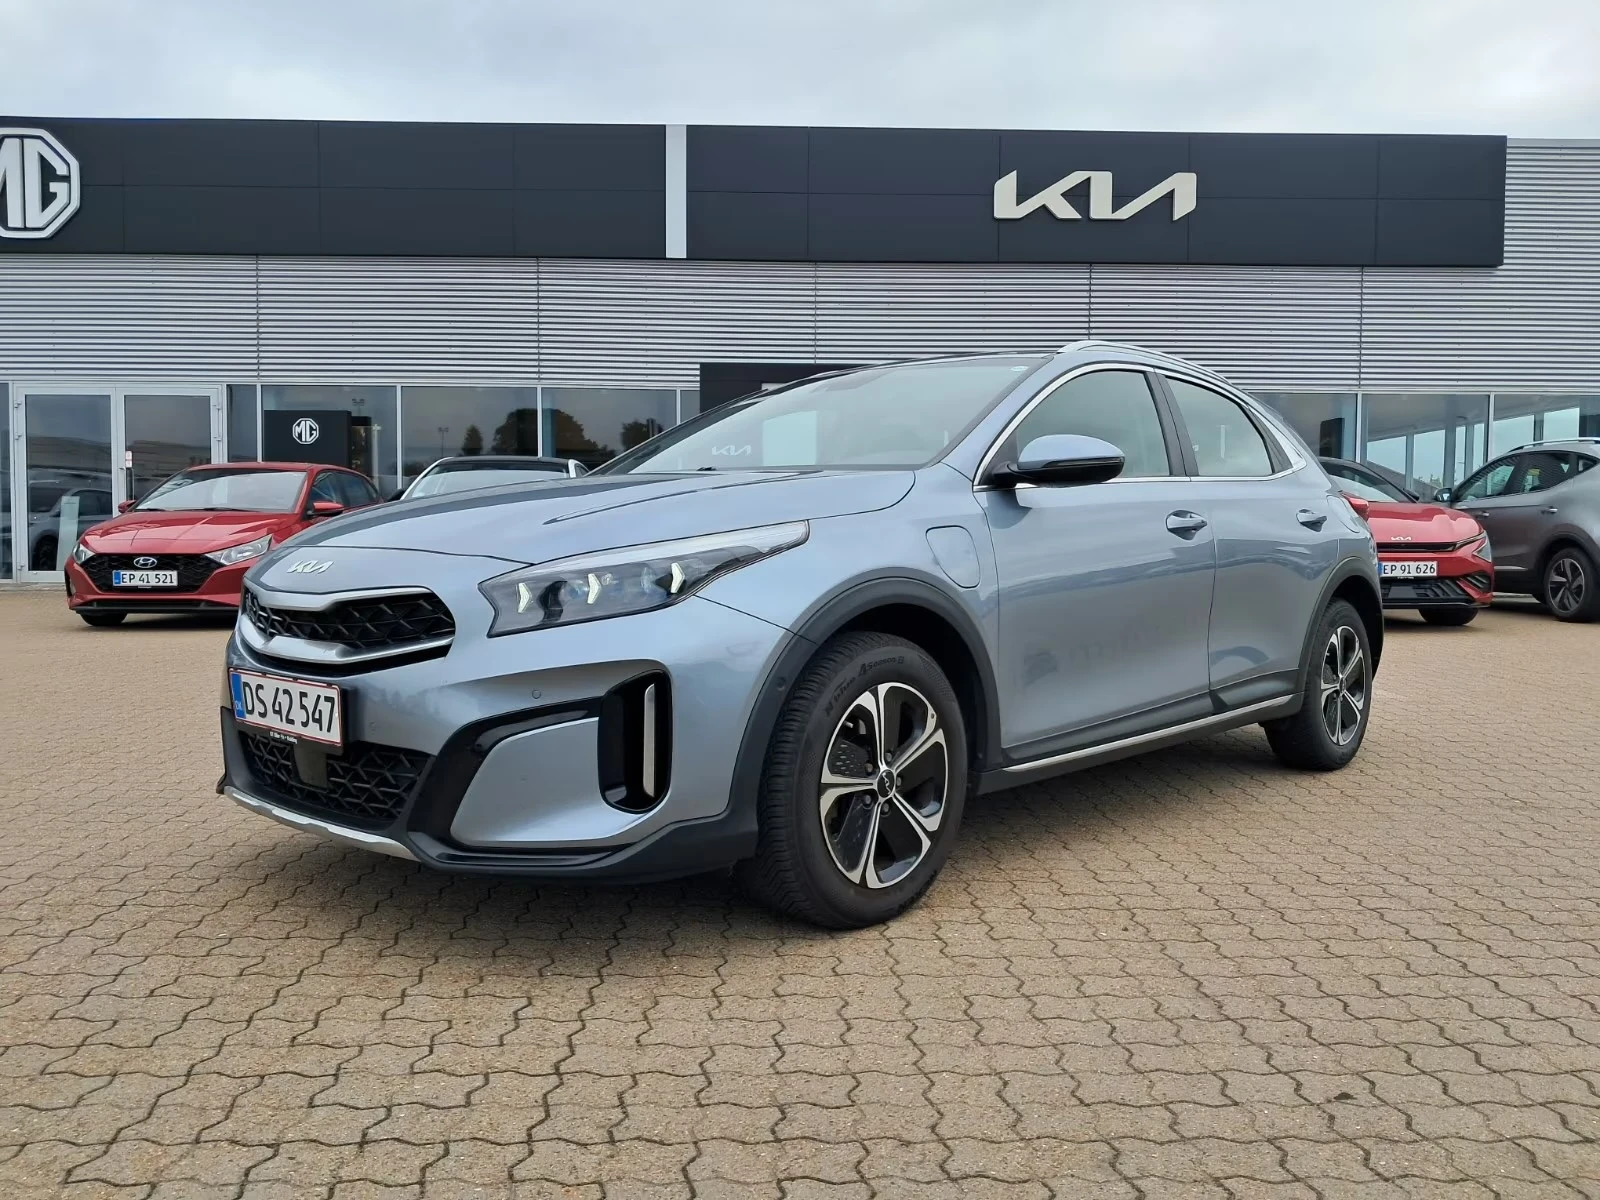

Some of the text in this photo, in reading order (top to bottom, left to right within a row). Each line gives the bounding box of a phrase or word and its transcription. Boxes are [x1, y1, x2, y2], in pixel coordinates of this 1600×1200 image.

[993, 169, 1197, 221] KIA
[295, 420, 317, 442] MG
[286, 559, 335, 575] KIA
[1383, 564, 1436, 575] EP 91 626
[121, 573, 174, 584] EP 41 521
[242, 681, 335, 733] DS 42 547
